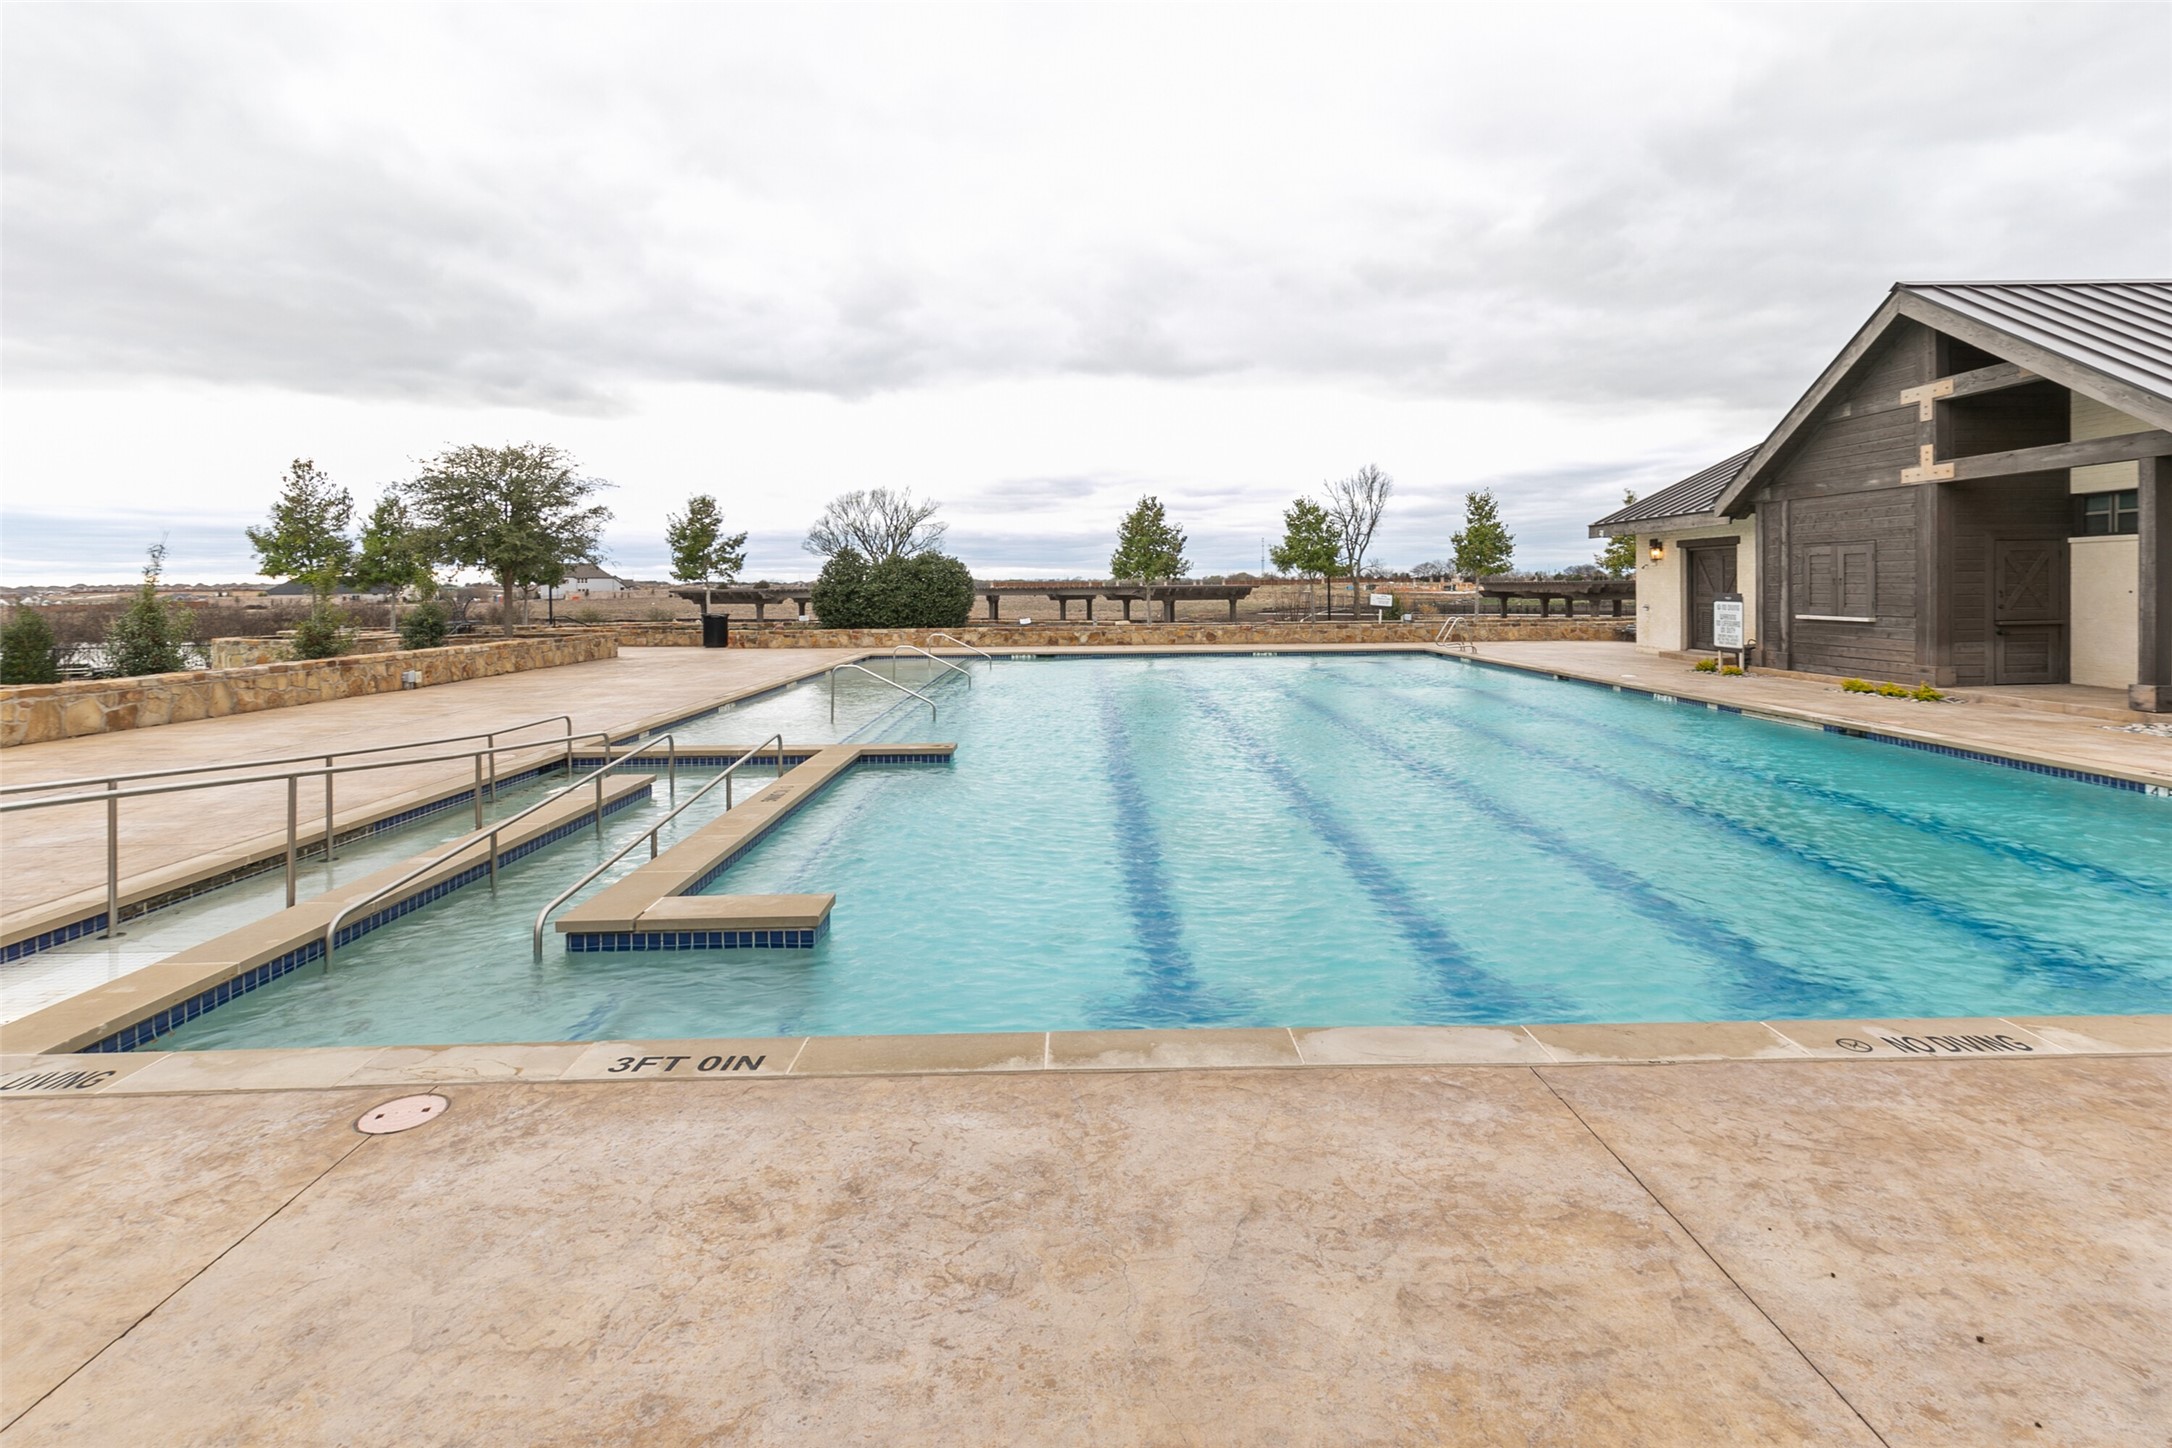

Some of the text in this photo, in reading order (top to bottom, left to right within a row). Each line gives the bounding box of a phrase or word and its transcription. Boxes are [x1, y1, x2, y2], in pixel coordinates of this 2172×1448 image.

[1880, 1034, 2033, 1053] NO DIVING
[607, 1056, 691, 1073] 3FT
[0, 1070, 116, 1090] DIVING
